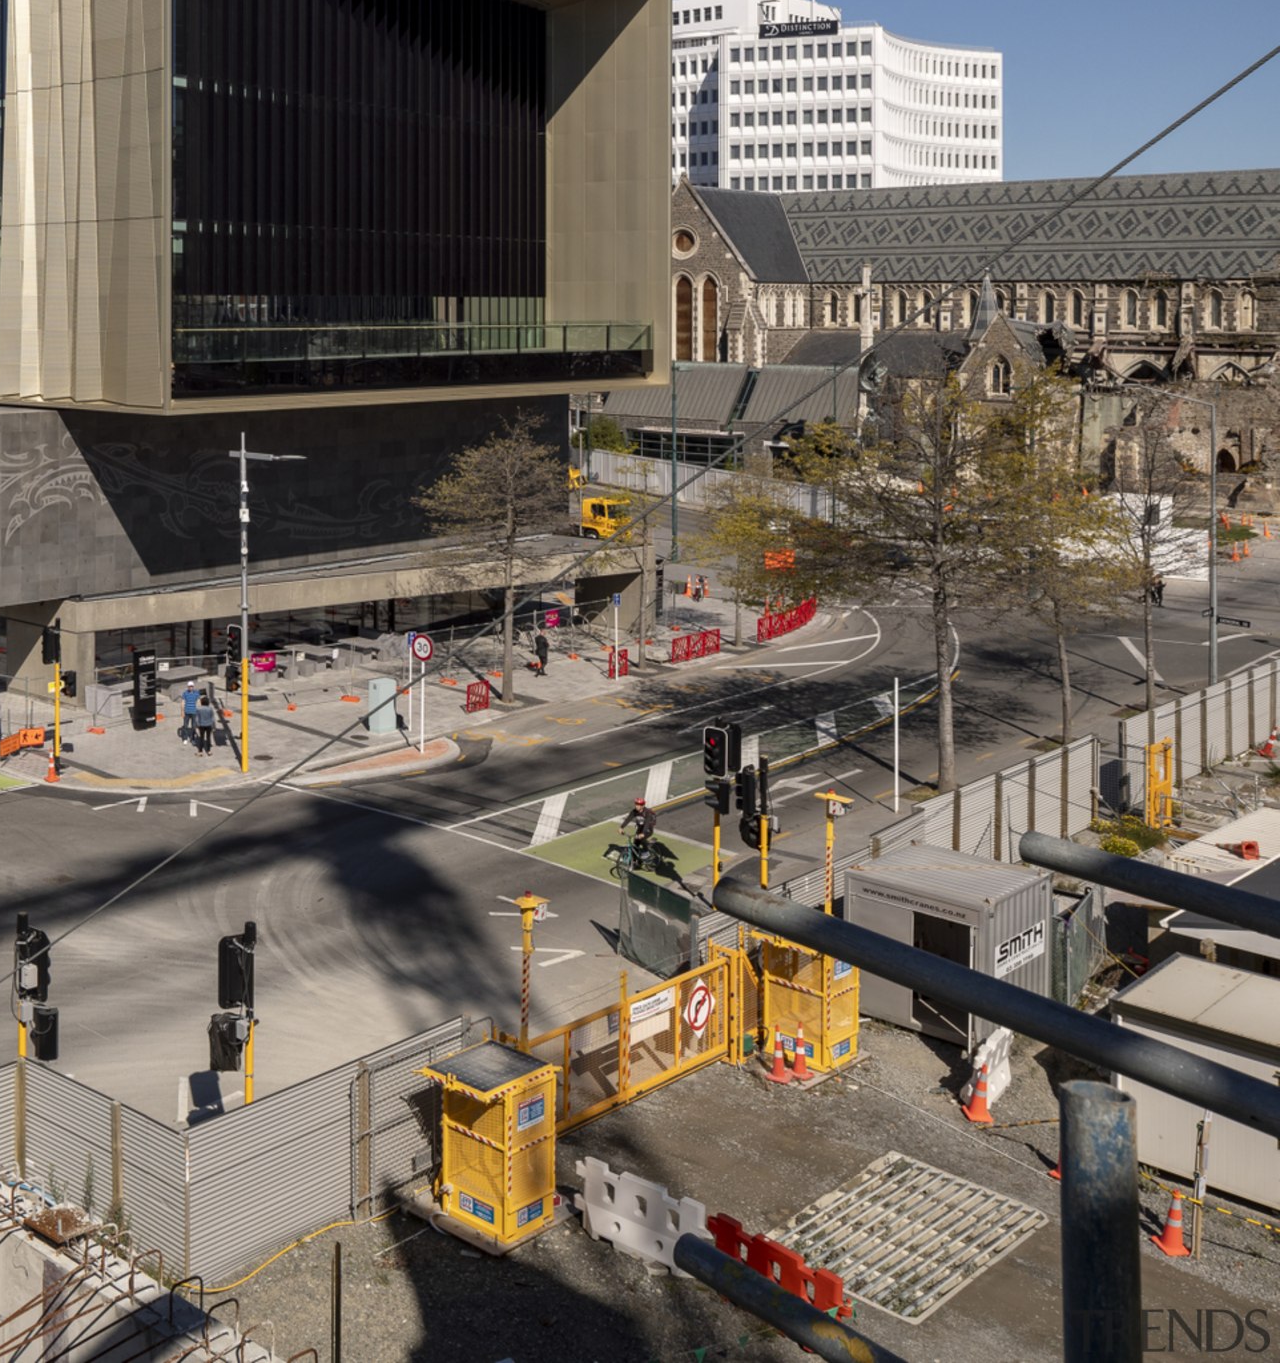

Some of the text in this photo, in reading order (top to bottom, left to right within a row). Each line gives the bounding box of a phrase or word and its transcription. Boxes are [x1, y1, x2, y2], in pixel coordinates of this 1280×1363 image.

[781, 23, 831, 32] DISTINCTION
[417, 641, 429, 654] 30
[862, 887, 966, 919] www.smithcranes.co.nz
